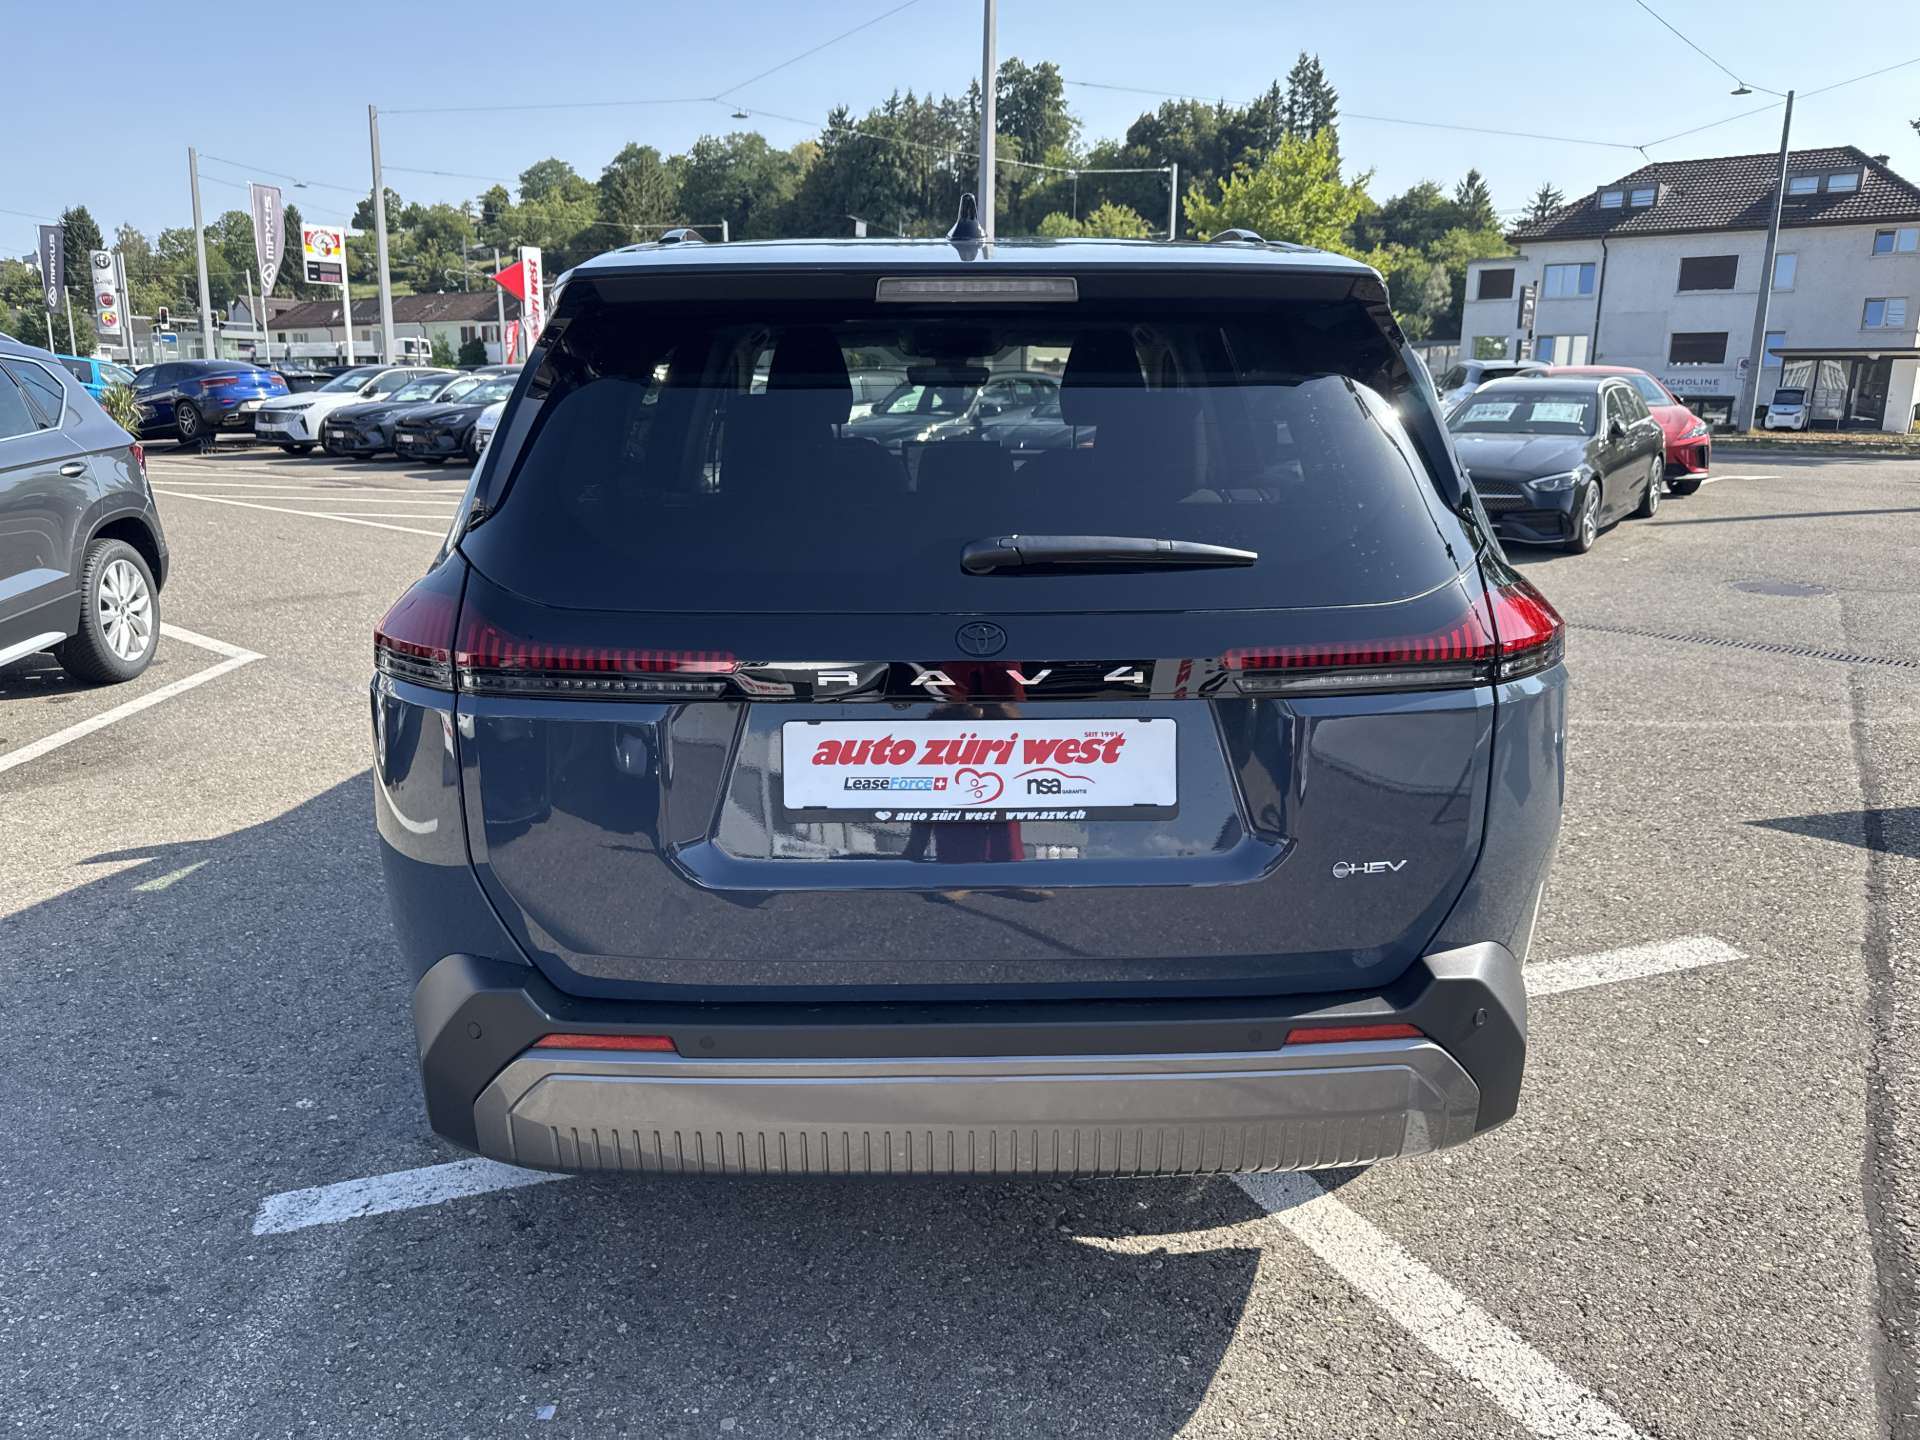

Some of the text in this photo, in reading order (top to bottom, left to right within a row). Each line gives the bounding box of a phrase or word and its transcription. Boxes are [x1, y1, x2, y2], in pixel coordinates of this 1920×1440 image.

[264, 195, 274, 260] MAXUS
[528, 258, 539, 296] west
[817, 665, 1144, 687] RAV4
[812, 733, 1127, 766] auto züri west
[843, 776, 934, 791] LeaseForce
[1027, 778, 1061, 795] nsa
[895, 809, 1087, 821] auto züri west www.azw.ch
